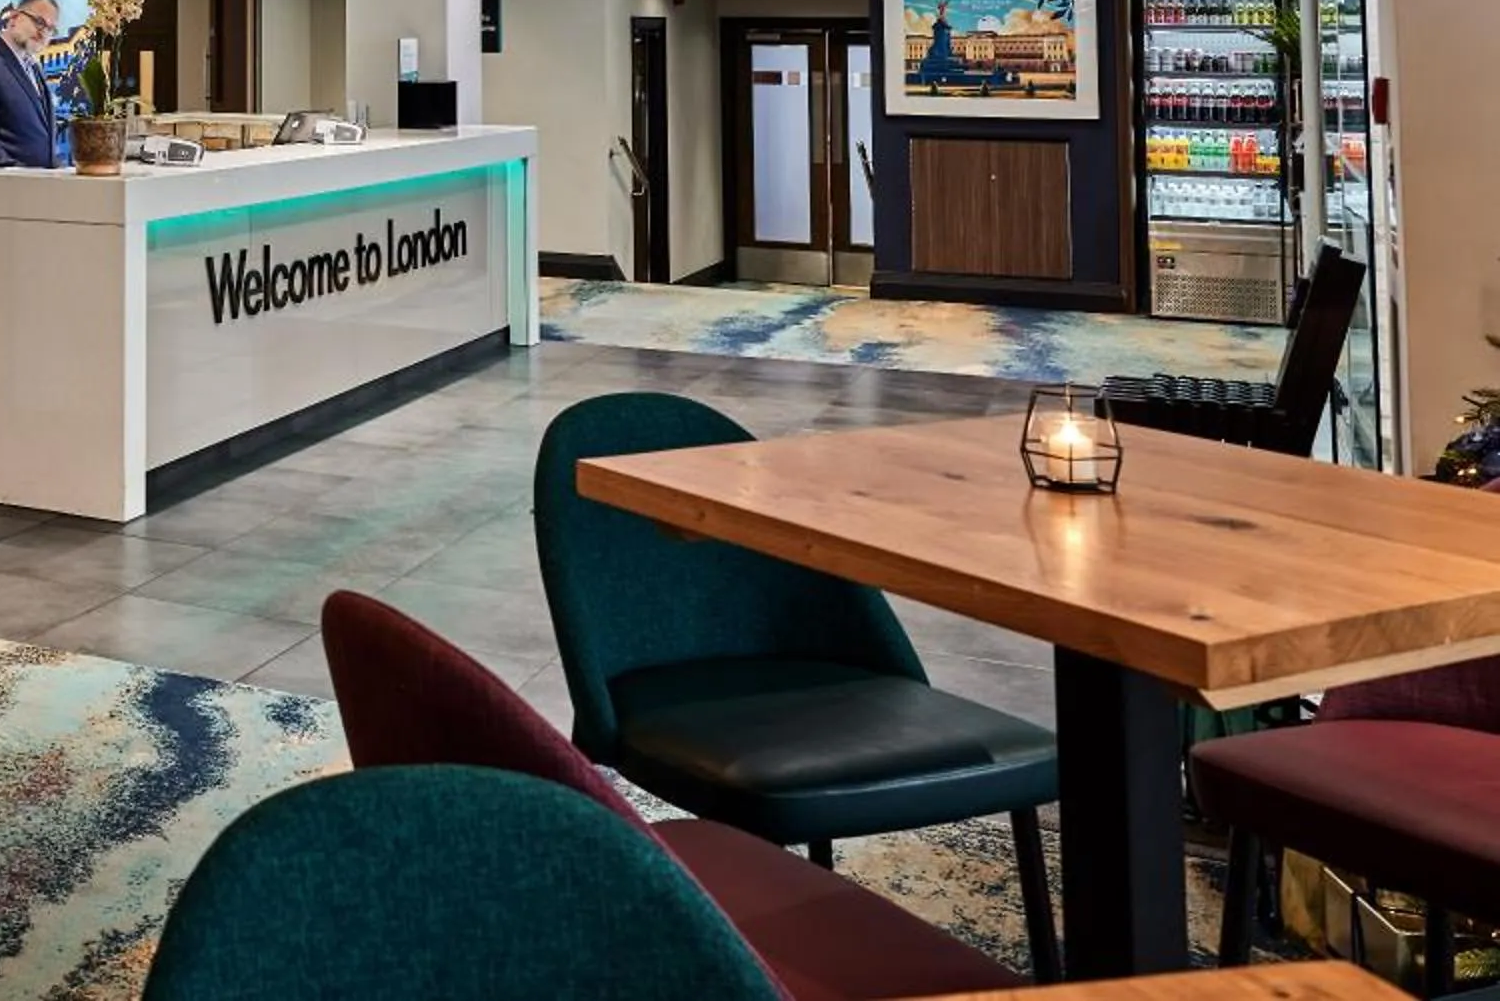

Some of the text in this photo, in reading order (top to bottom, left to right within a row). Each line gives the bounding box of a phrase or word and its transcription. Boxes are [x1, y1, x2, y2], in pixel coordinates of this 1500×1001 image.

[206, 209, 467, 324] Welcome to London
